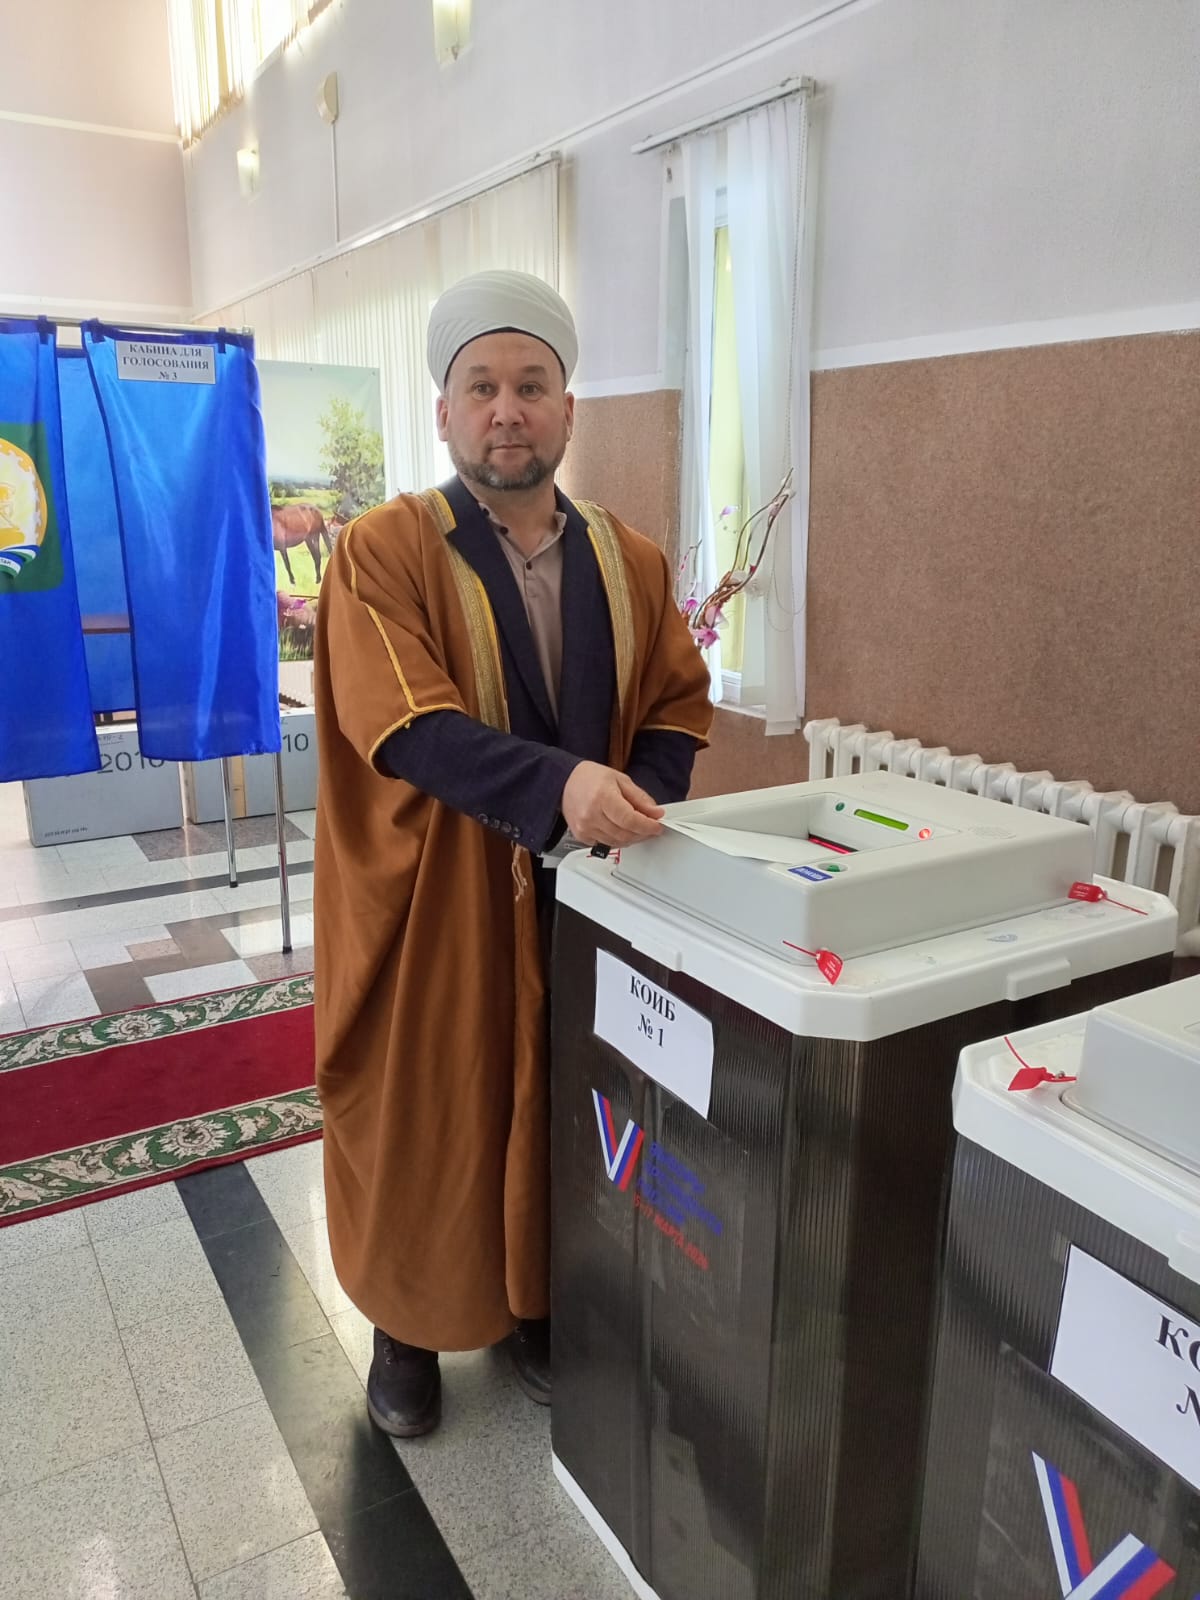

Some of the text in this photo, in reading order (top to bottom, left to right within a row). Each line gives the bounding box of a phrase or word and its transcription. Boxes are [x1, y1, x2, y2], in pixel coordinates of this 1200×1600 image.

[129, 344, 202, 357] КАБИНА ДЛЯ
[123, 356, 209, 369] ГОЛОСОВАНИЯ
[158, 371, 178, 380] № 3
[630, 975, 676, 1022] КОИБ
[637, 1012, 664, 1048] № 1
